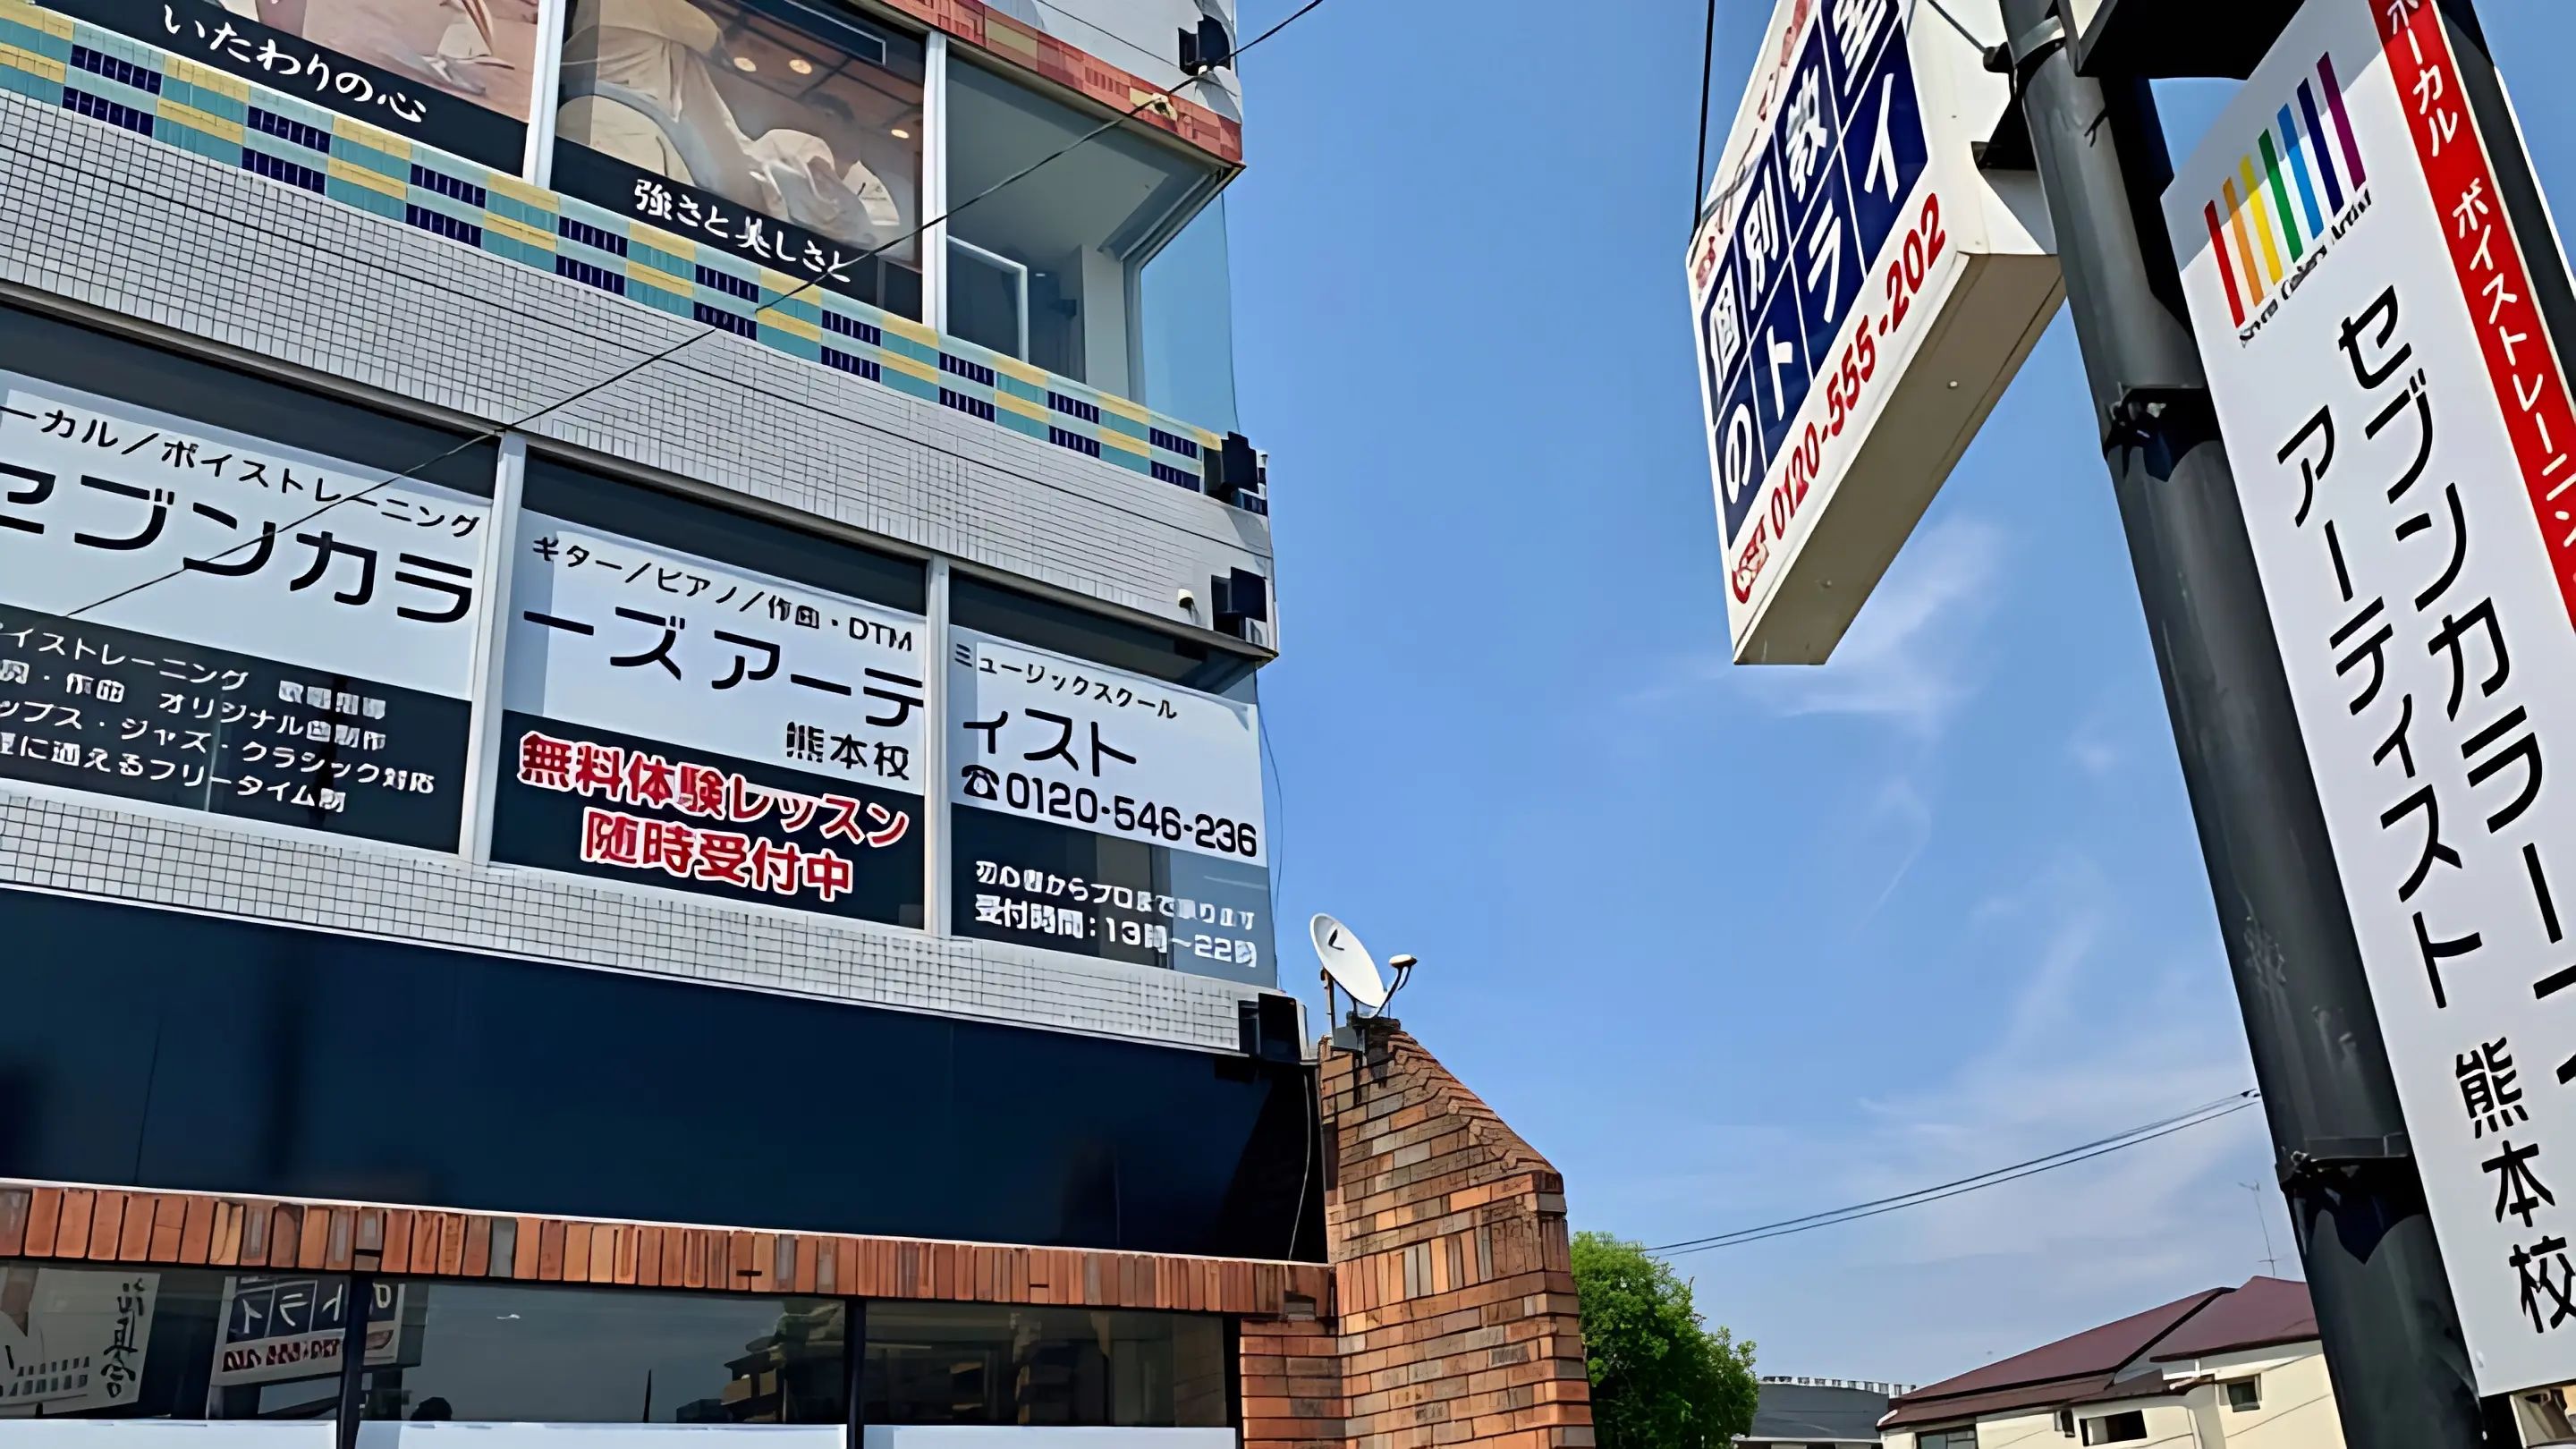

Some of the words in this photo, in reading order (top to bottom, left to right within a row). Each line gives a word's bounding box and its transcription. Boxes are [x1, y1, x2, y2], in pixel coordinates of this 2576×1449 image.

[163, 3, 428, 123] いたわりの心
[634, 178, 851, 283] 強さと美しさと
[1725, 72, 1898, 504] のトライ
[1771, 192, 1946, 540] 0120-555-202
[0, 623, 250, 691] イストレーニング
[2276, 403, 2483, 1010] アーティスト
[516, 730, 910, 848] 無料体験レッスン
[785, 720, 910, 781] 熊本校
[580, 805, 854, 902] 随時受付中
[2454, 1035, 2576, 1335] 熊本校
